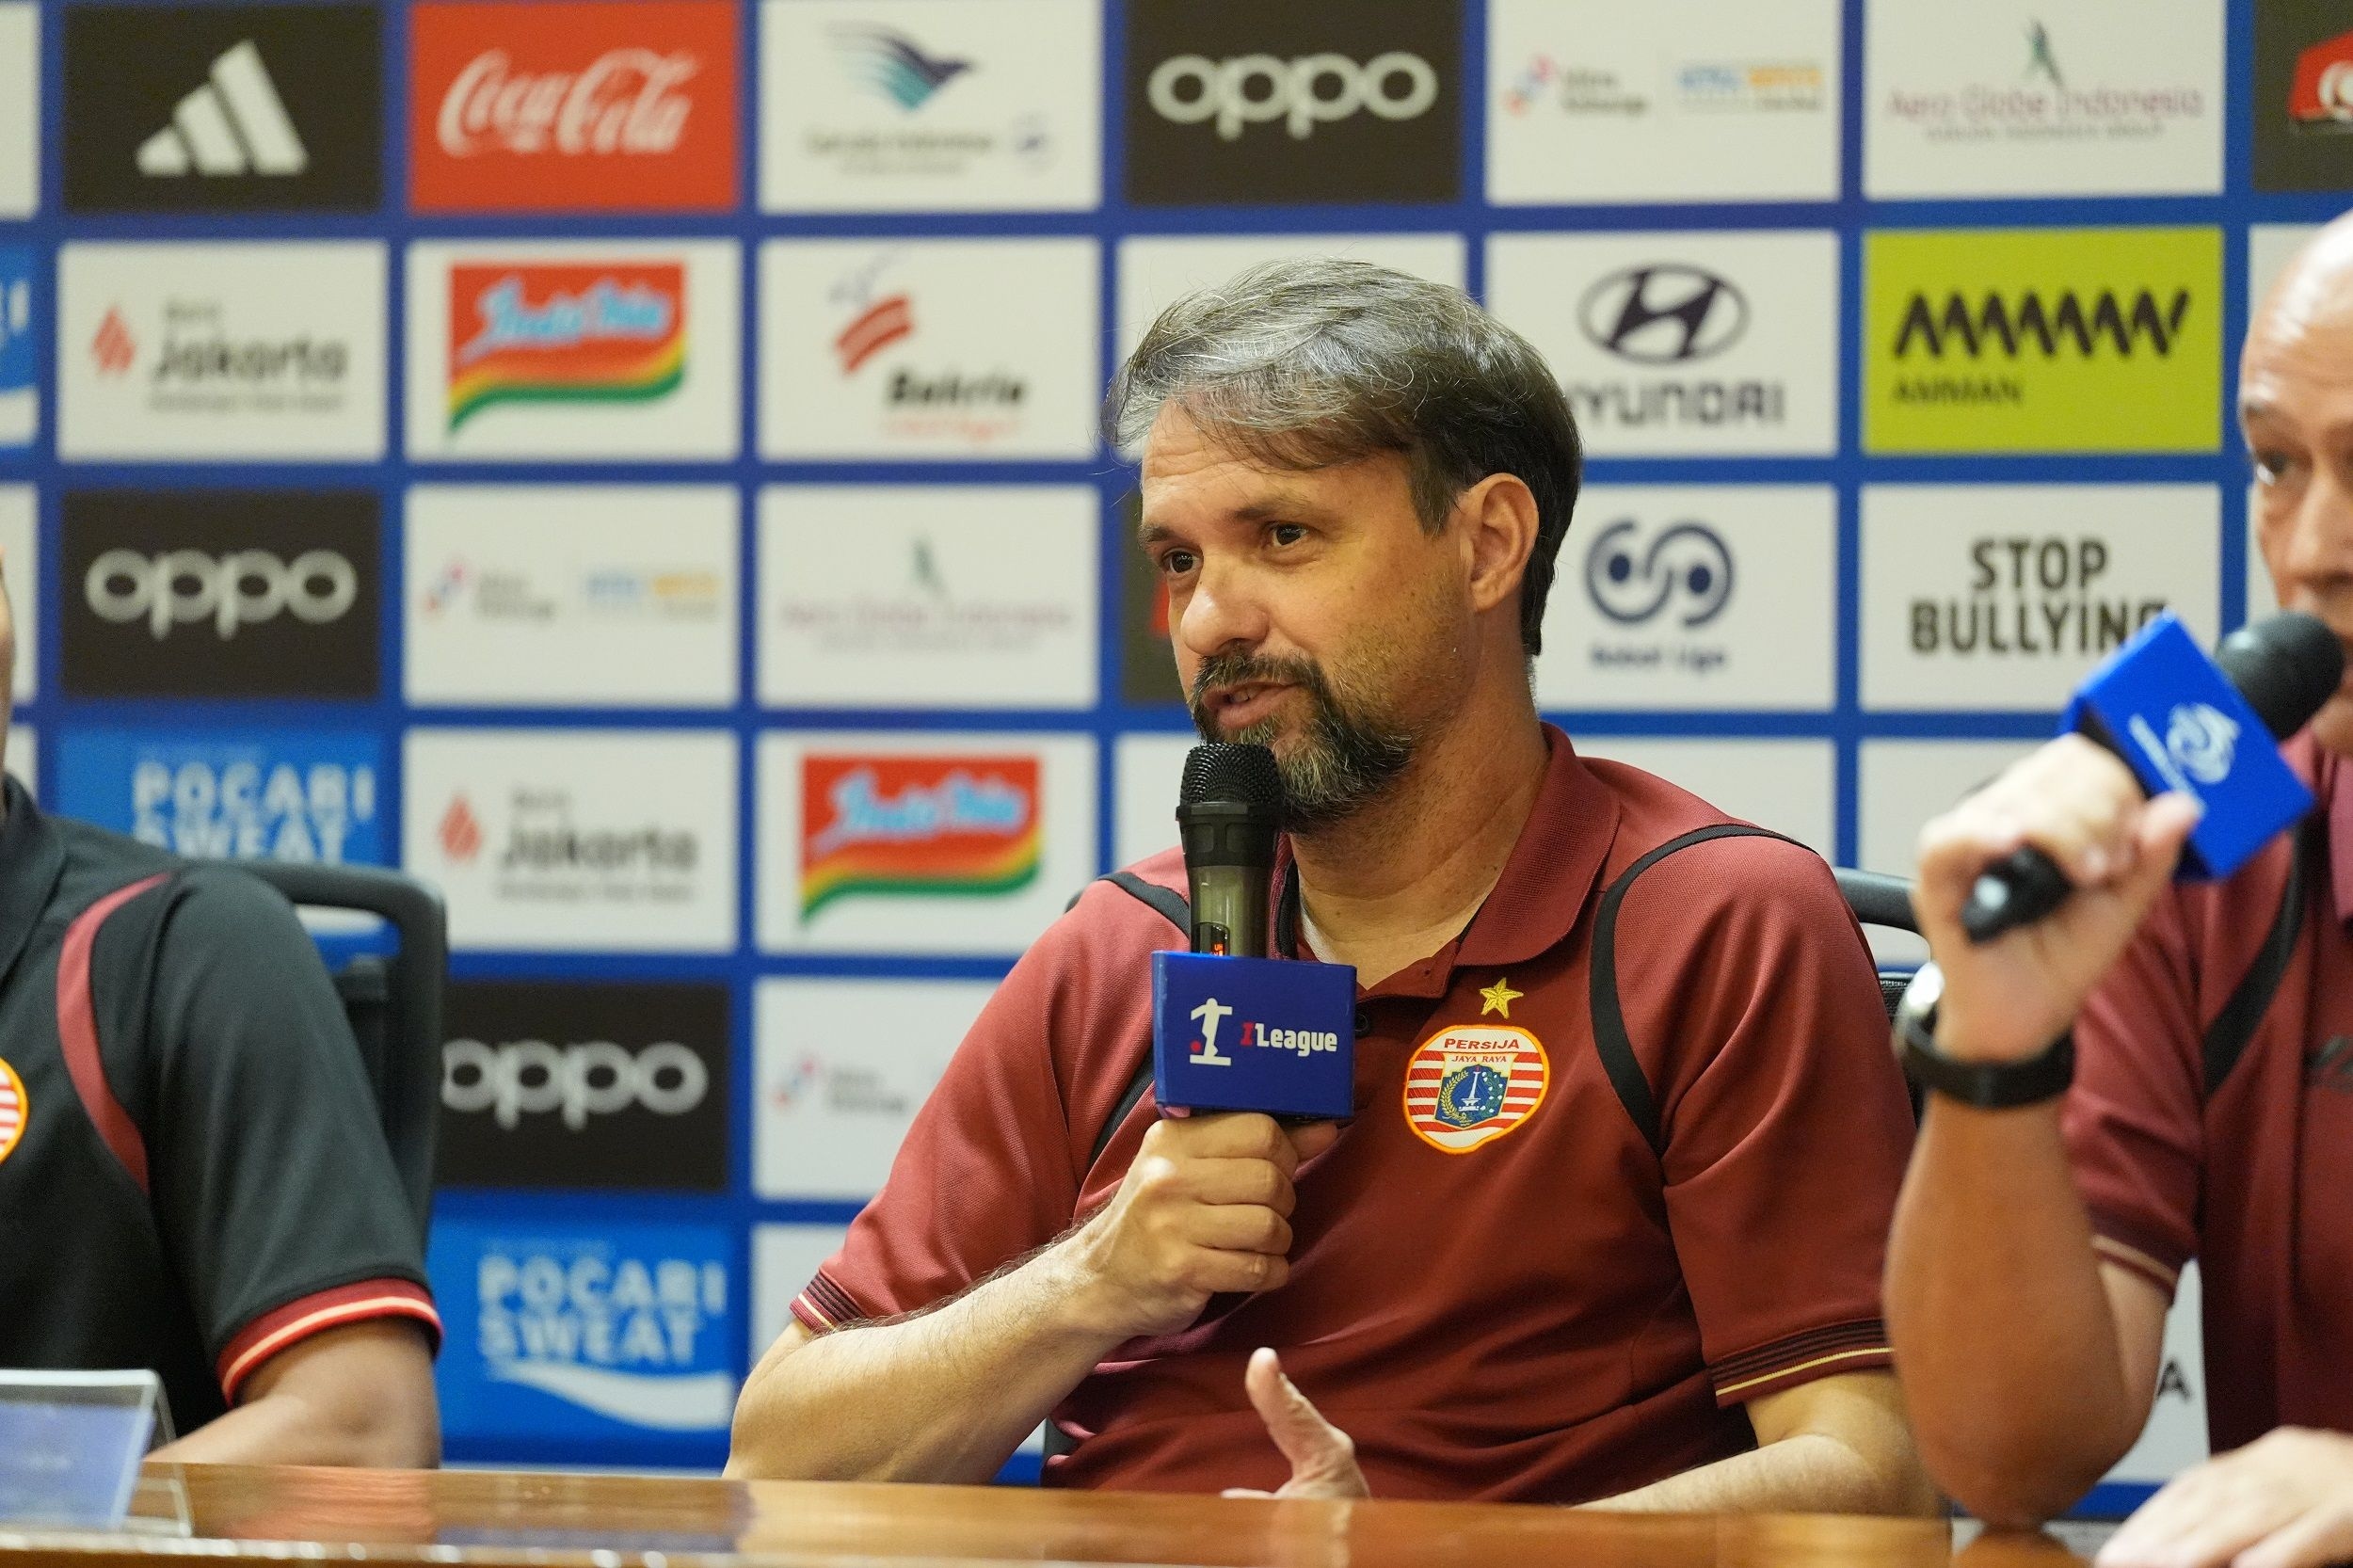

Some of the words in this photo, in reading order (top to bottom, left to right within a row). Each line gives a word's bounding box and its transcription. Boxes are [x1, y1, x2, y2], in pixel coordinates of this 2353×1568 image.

[1148, 52, 1437, 140] oppo
[1570, 381, 1786, 426] YUNDAI
[1972, 538, 2108, 591] STOP
[86, 549, 358, 640] oppo
[134, 760, 375, 819] POCARI
[1444, 1038, 1520, 1050] PERSIJA
[478, 1256, 727, 1316] POCARI
[478, 1306, 698, 1365] SWEAT
